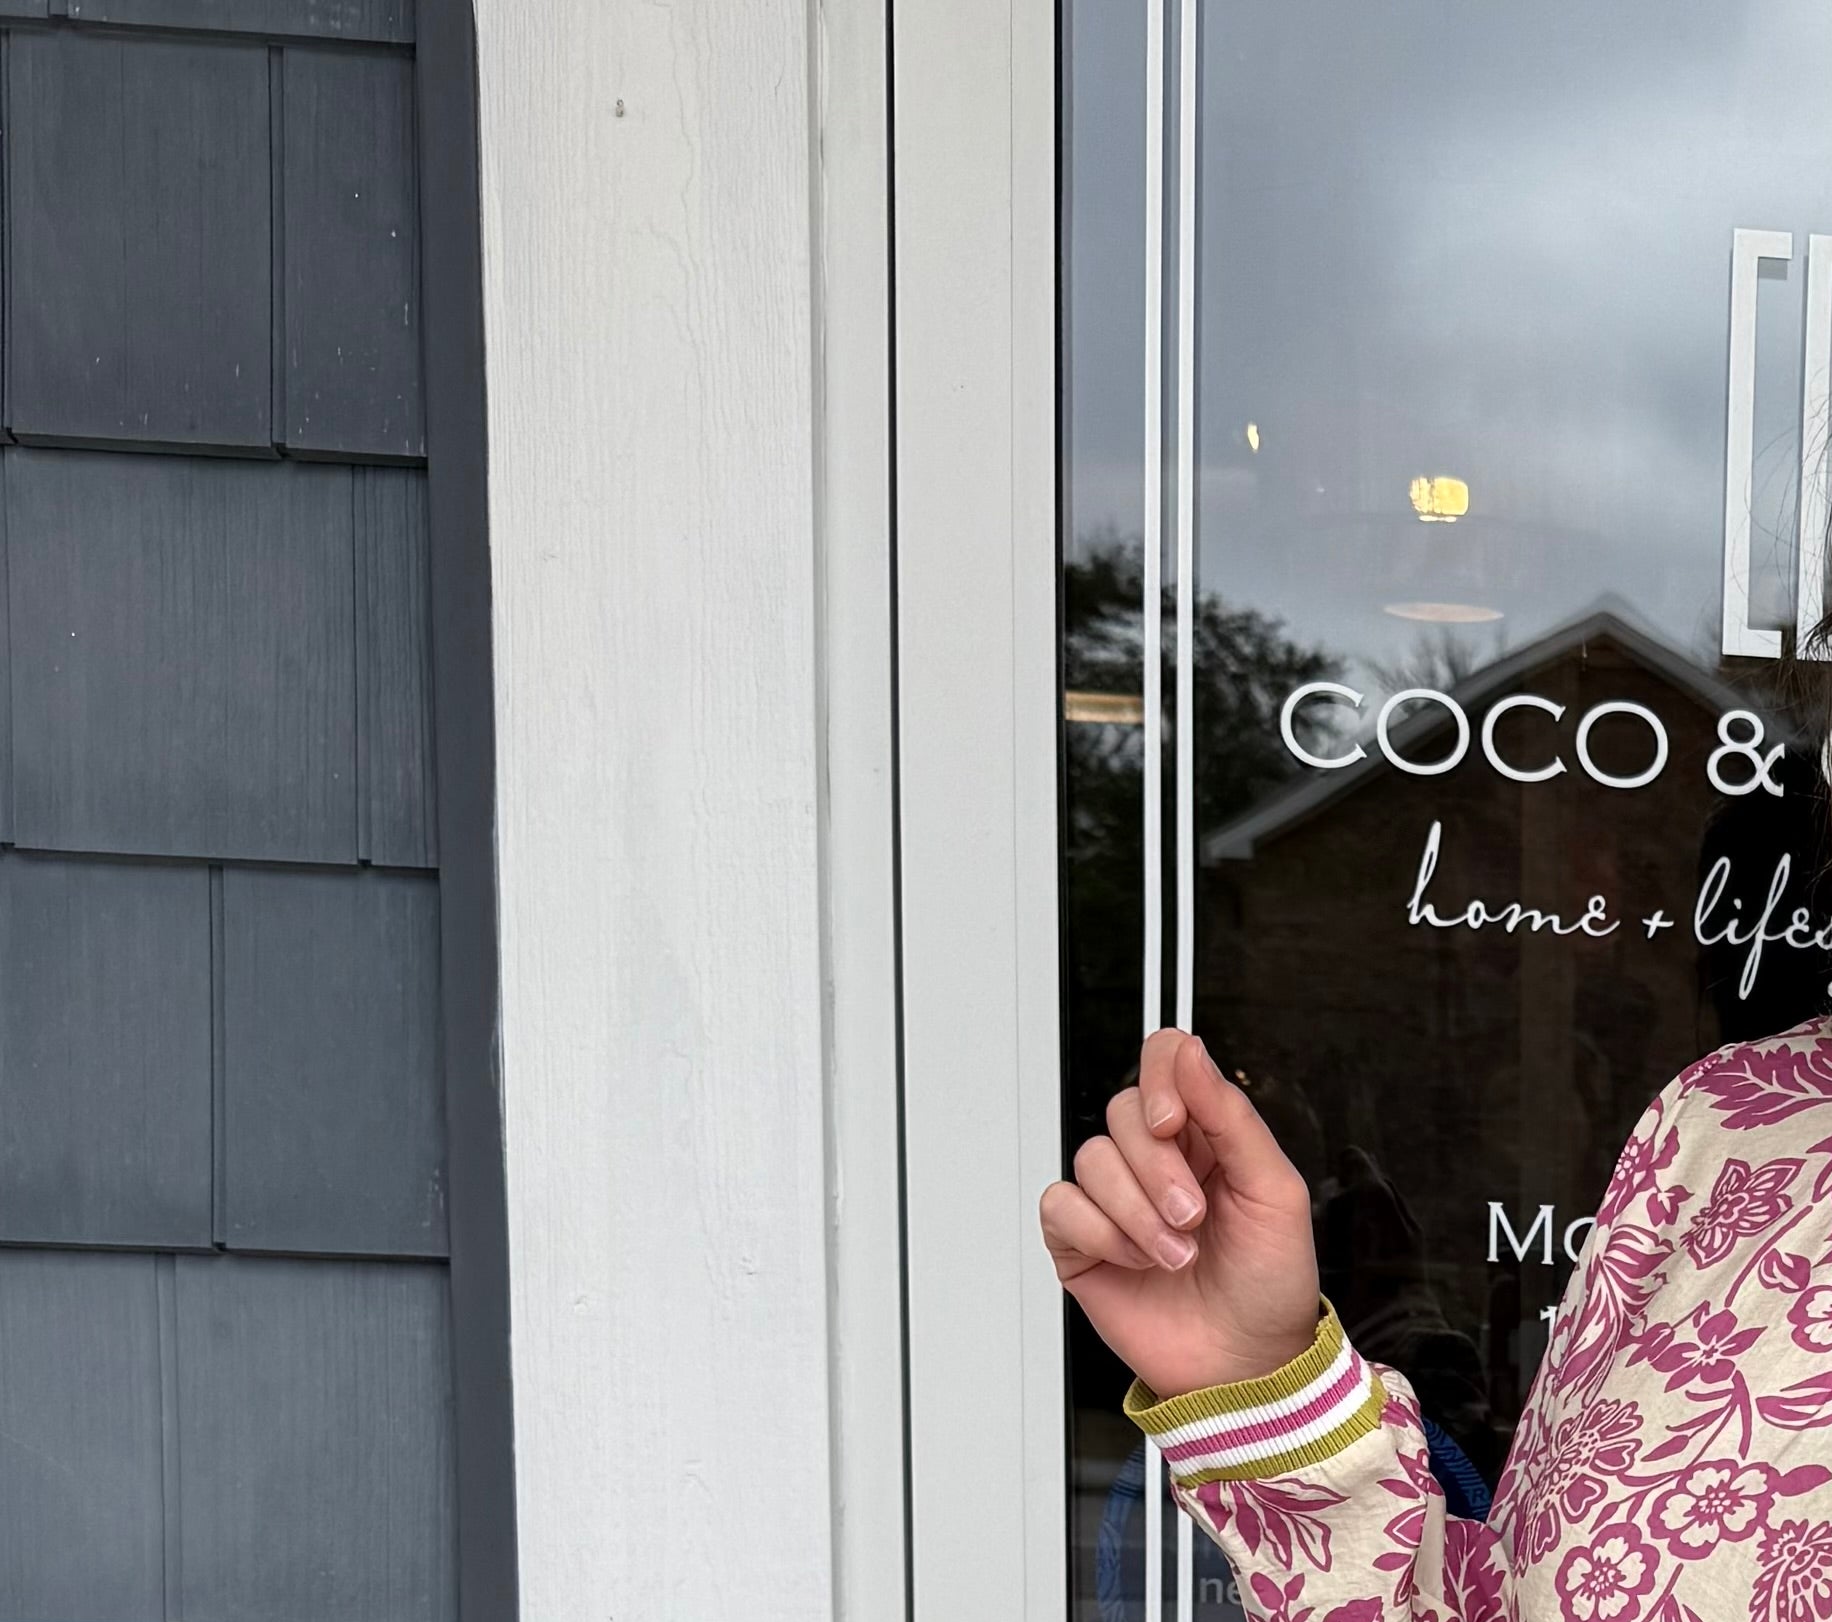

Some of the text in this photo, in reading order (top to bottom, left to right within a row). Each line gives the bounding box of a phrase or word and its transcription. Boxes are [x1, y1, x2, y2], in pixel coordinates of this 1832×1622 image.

[1280, 682, 1669, 789] COCO
[1706, 709, 1786, 798] &
[1406, 819, 1621, 938] home
